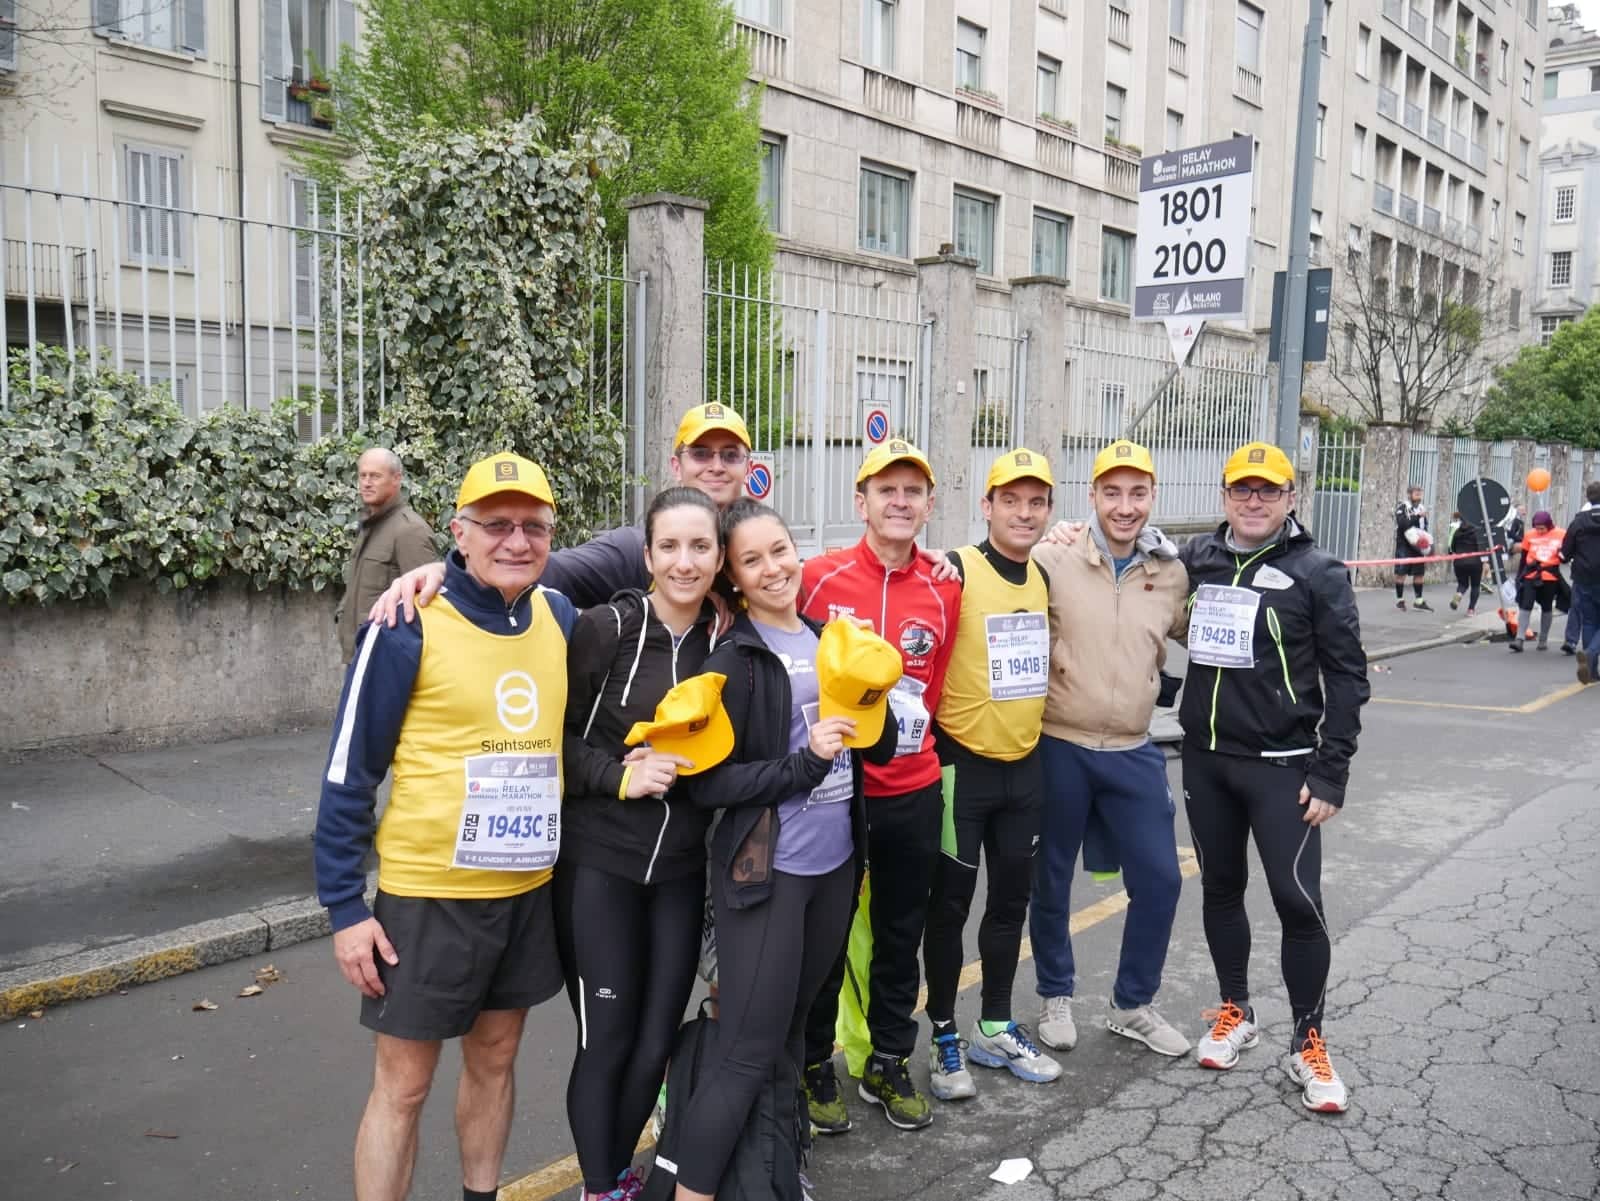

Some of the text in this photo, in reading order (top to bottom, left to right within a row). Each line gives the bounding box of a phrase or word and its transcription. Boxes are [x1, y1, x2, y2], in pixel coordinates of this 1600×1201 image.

[1182, 147, 1212, 165] RELAY
[1181, 156, 1236, 178] MARATHON
[1160, 183, 1222, 227] 1801
[1153, 238, 1226, 278] 2100
[1192, 291, 1221, 303] MILANO
[1201, 625, 1236, 645] 1942B
[1007, 656, 1040, 676] 1941B
[481, 738, 552, 753] Sightsavers
[501, 792, 542, 800] MARATHON
[502, 784, 531, 793] RELAY
[487, 813, 543, 838] 1943C
